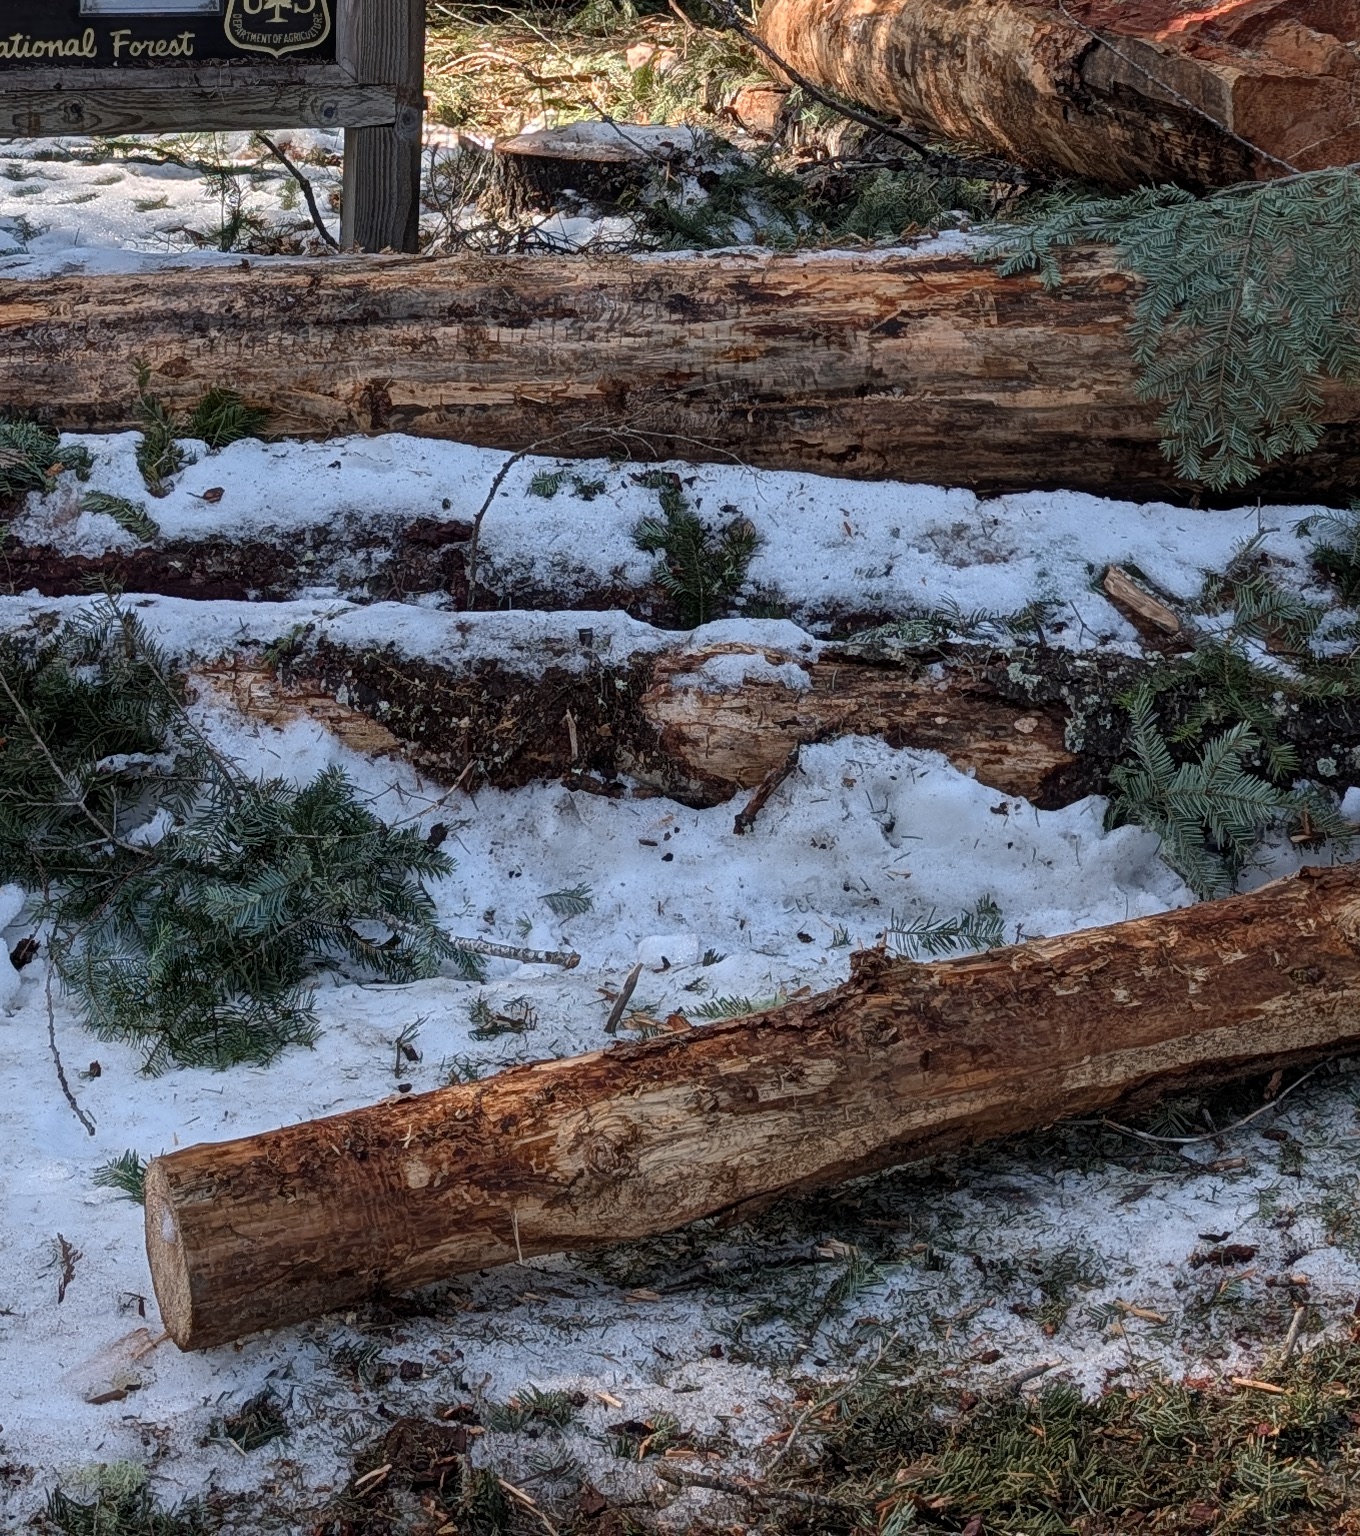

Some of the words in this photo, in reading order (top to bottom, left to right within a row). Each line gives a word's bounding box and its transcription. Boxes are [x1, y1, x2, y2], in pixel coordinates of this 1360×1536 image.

[232, 13, 272, 43] DEPARTMENT
[272, 34, 283, 43] OF
[284, 13, 323, 43] AGRICULTURE
[110, 29, 195, 57] Forest
